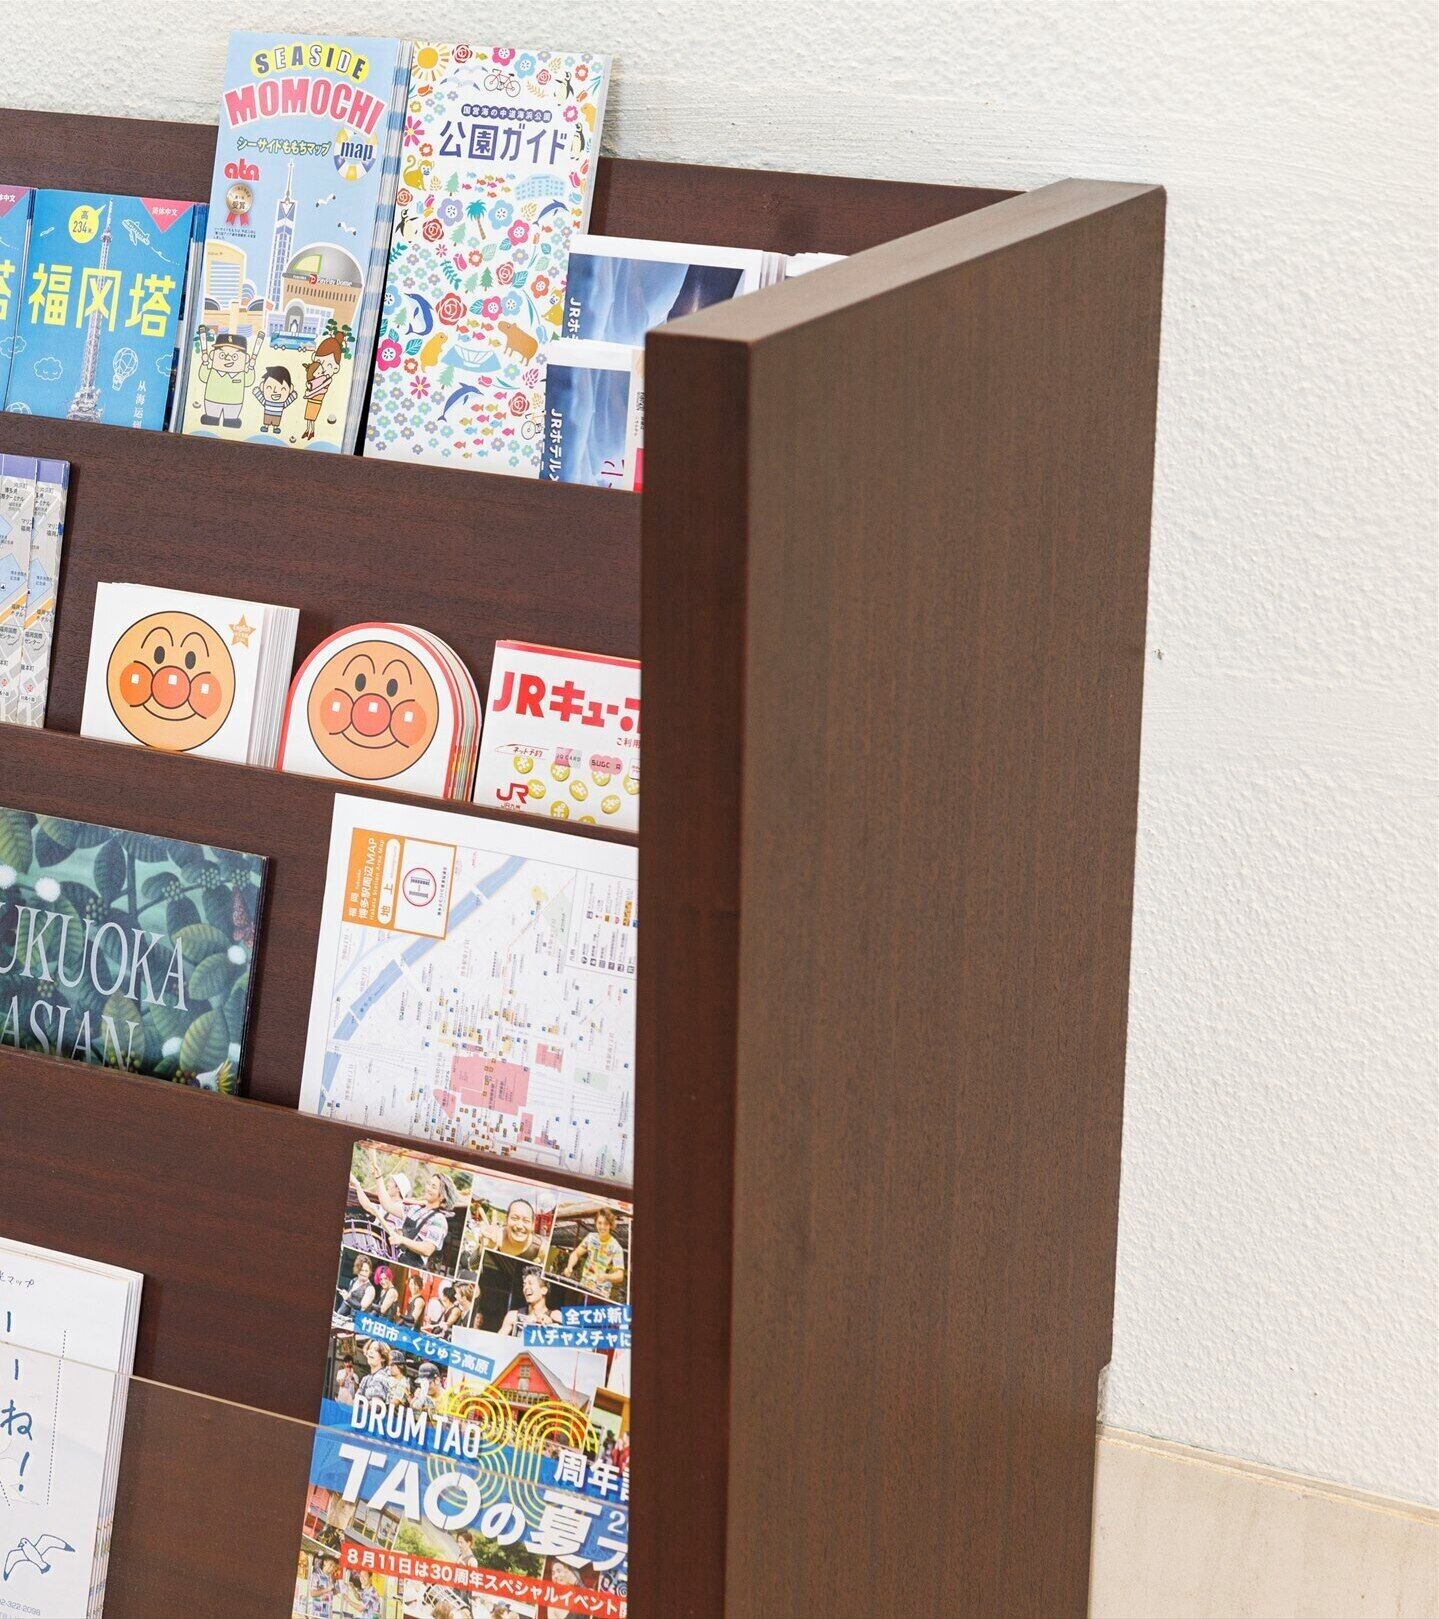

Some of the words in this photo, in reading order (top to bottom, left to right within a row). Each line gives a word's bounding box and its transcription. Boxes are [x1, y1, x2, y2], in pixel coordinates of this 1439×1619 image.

[255, 44, 366, 79] SEASIDE
[224, 78, 385, 135] MOMOCHI
[237, 137, 331, 156] シーサイドももちマップ
[341, 141, 373, 162] map
[439, 120, 567, 165] 公園ガイド
[28, 262, 176, 338] 福冈塔
[496, 782, 529, 804] JR
[367, 837, 377, 865] MAP
[380, 882, 394, 918] 地上
[0, 994, 140, 1072] ASIAN
[360, 1317, 490, 1375] 竹田市・くじゅう高原
[529, 1327, 632, 1348] ハチャメチャに
[350, 1393, 428, 1448] DRUM
[433, 1412, 482, 1460] TAO
[338, 1442, 628, 1572] TAOの夏フ
[607, 1509, 629, 1534] 2
